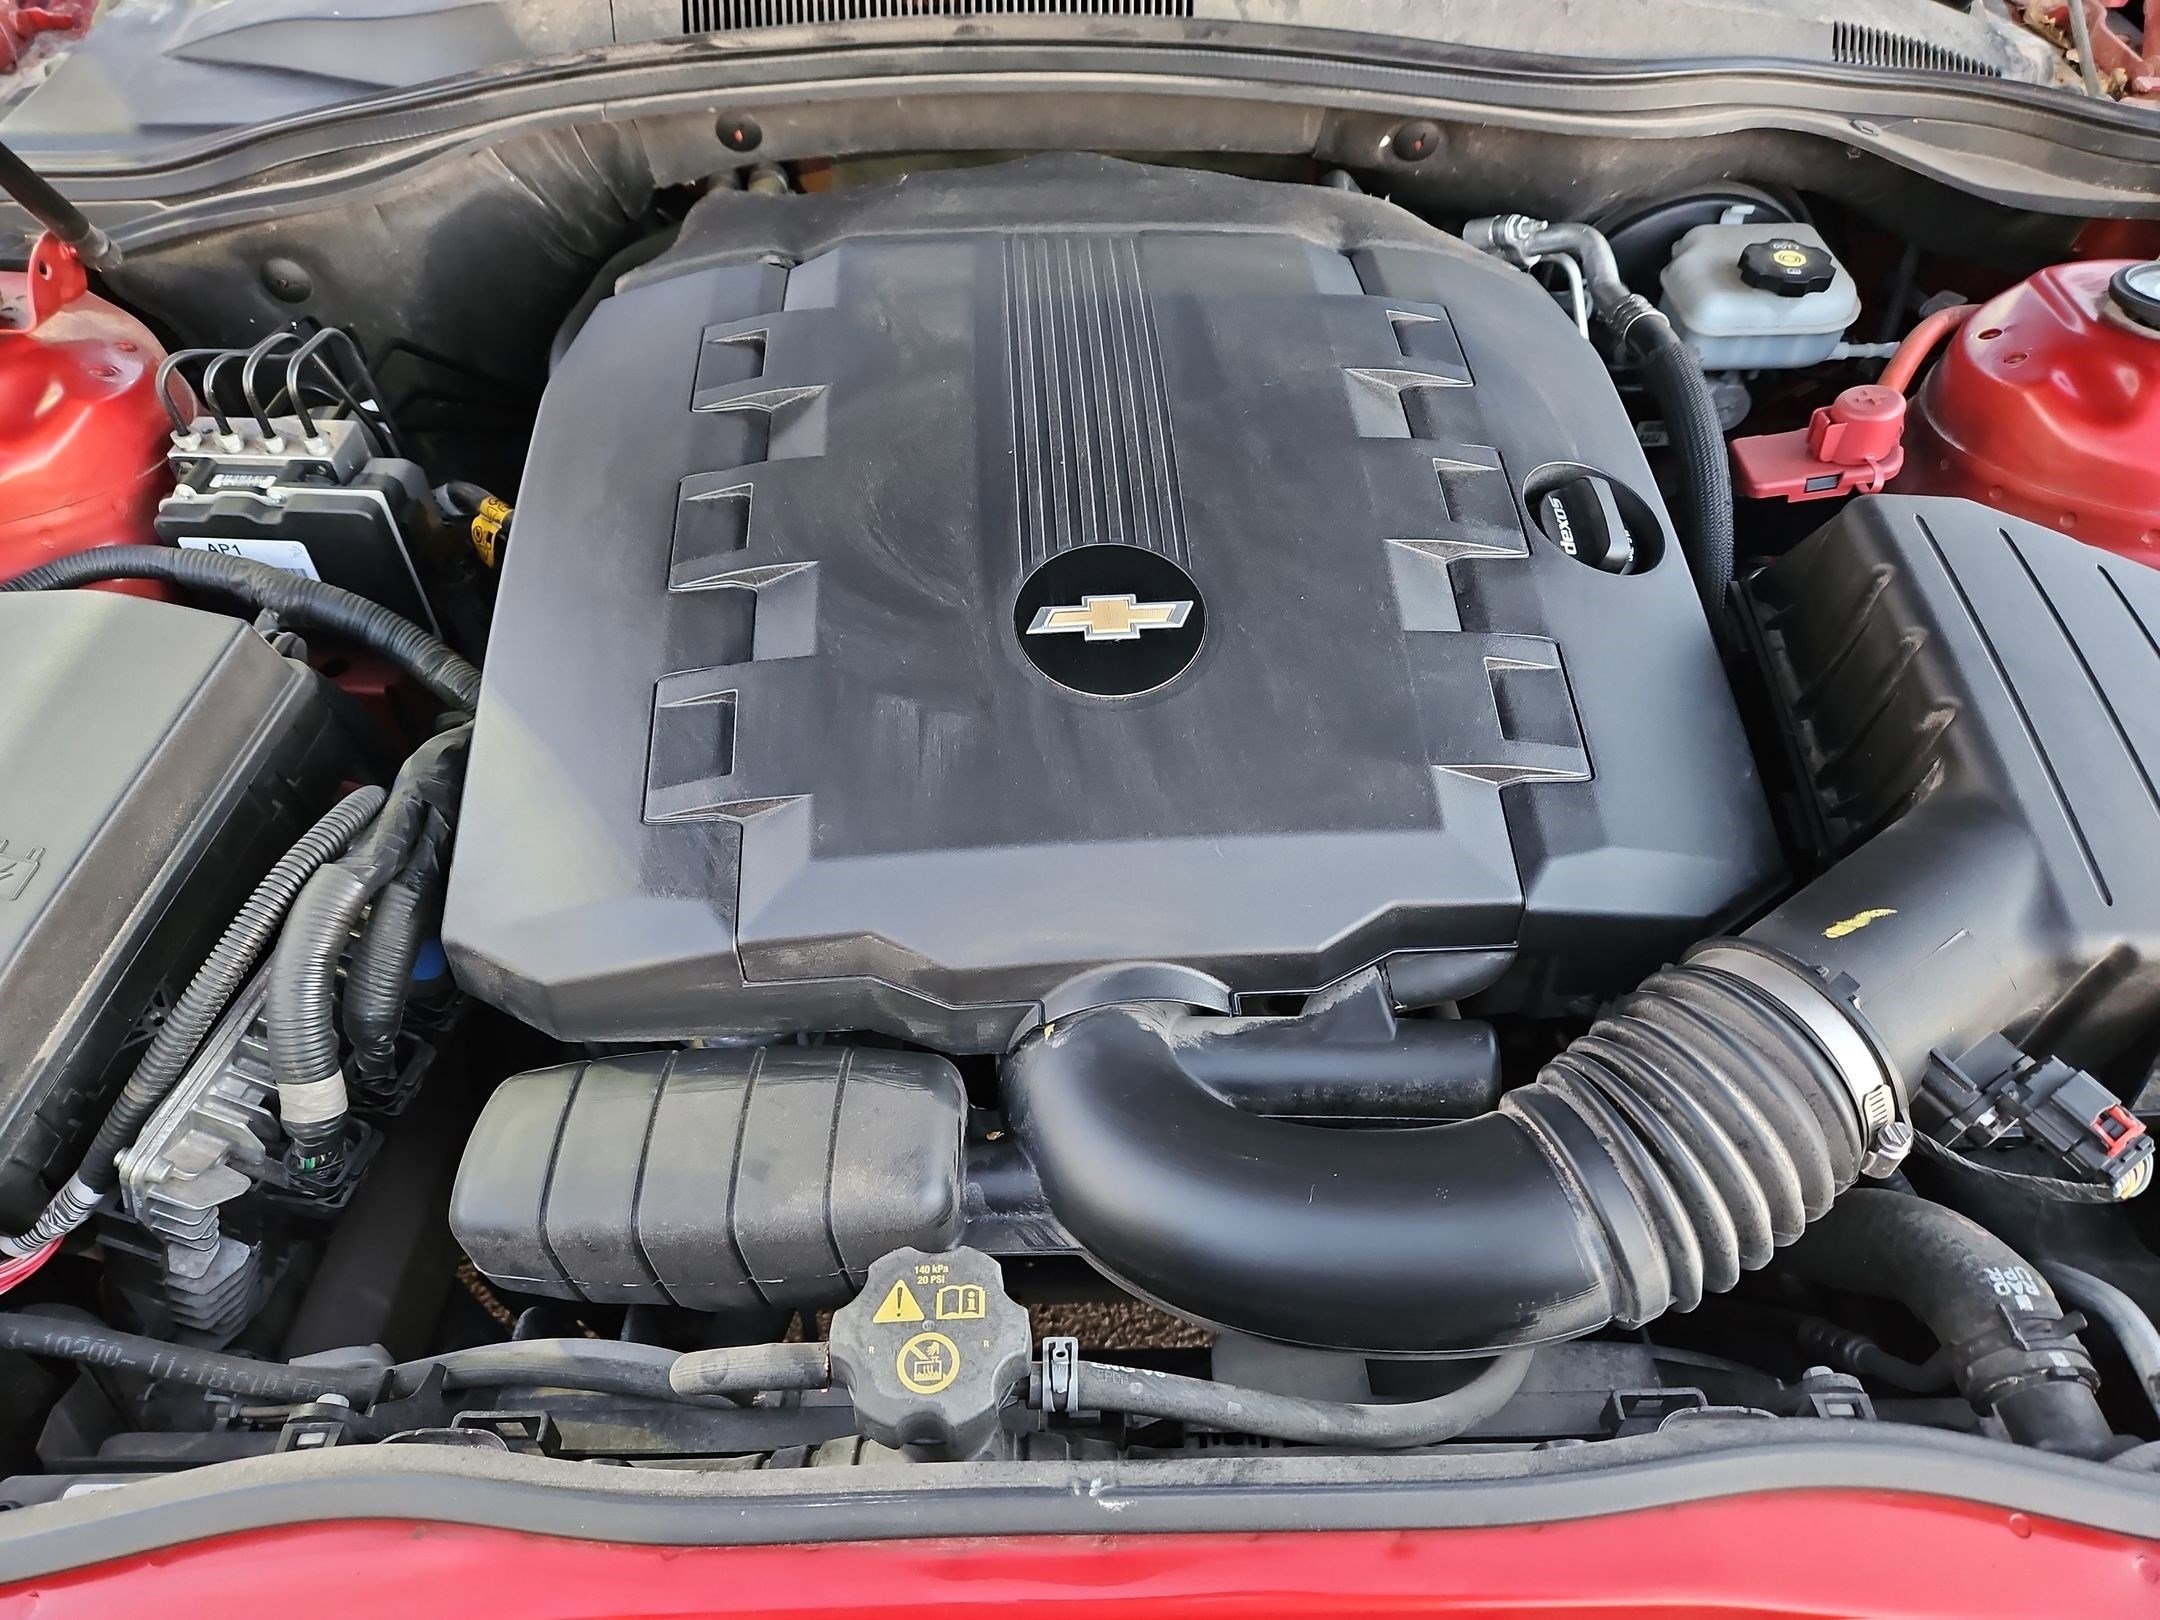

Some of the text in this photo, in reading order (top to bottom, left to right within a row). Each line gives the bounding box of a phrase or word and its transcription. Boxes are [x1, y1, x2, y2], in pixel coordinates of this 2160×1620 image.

[1547, 494, 1577, 556] dexos
[207, 542, 242, 556] AP1
[914, 1264, 949, 1275] 140 kPa
[1983, 1265, 2033, 1282] UPR
[917, 1275, 945, 1285] 20 PSI
